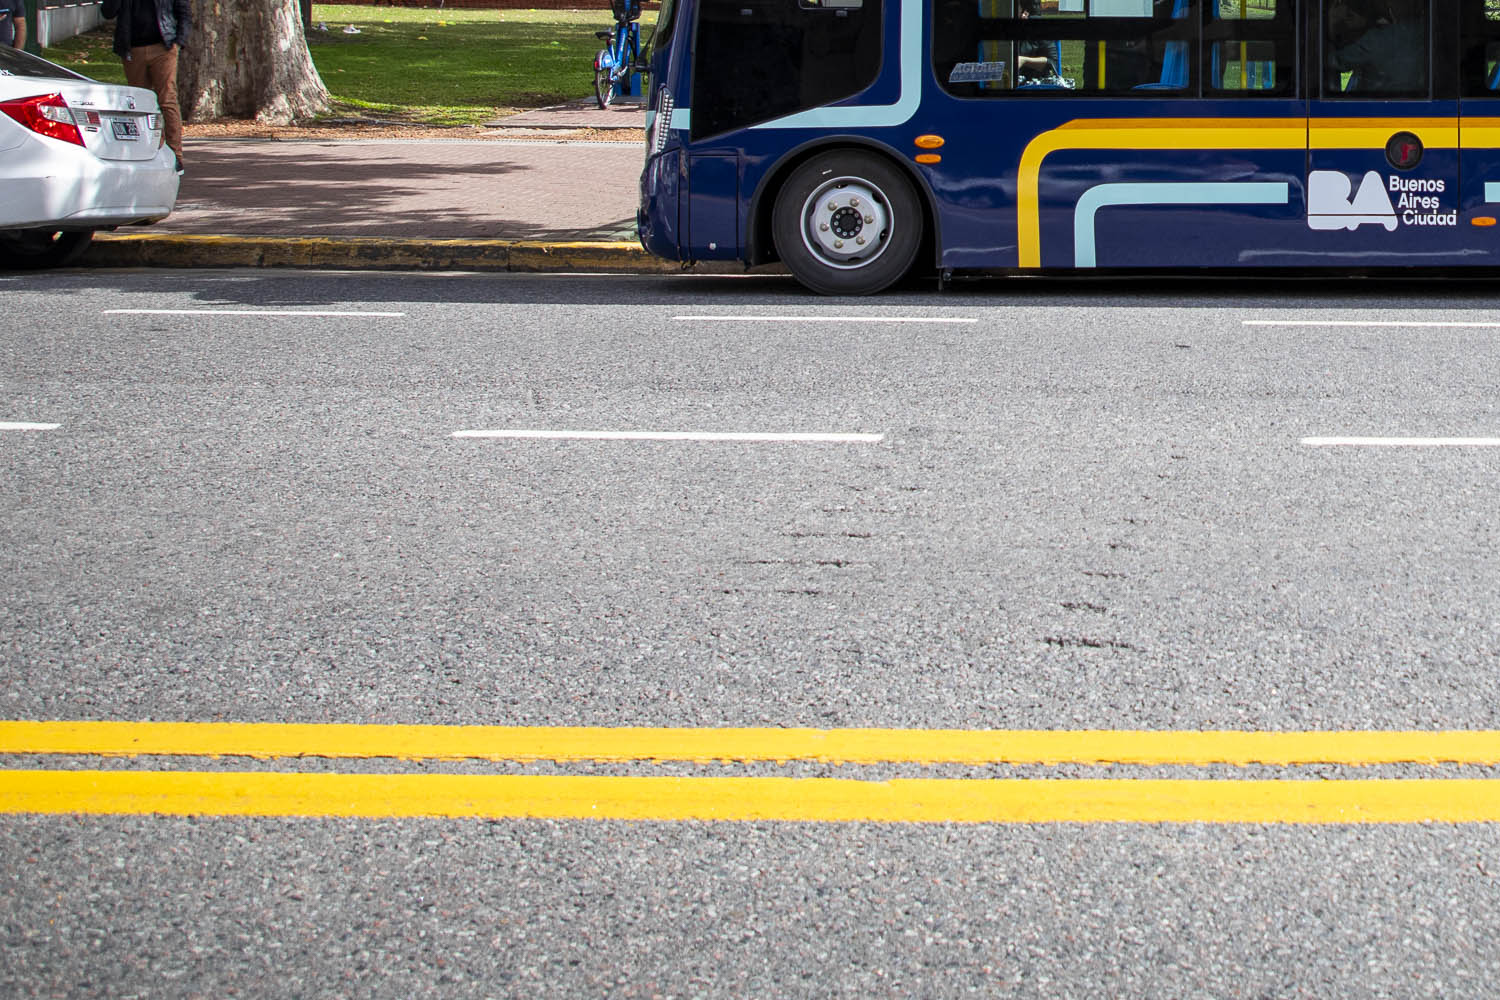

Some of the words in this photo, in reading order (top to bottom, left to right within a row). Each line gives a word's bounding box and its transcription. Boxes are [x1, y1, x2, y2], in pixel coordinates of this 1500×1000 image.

[1389, 176, 1445, 192] Buenos
[1308, 171, 1398, 231] BA
[1398, 193, 1440, 208] Aires
[1403, 210, 1457, 225] Ciudad
